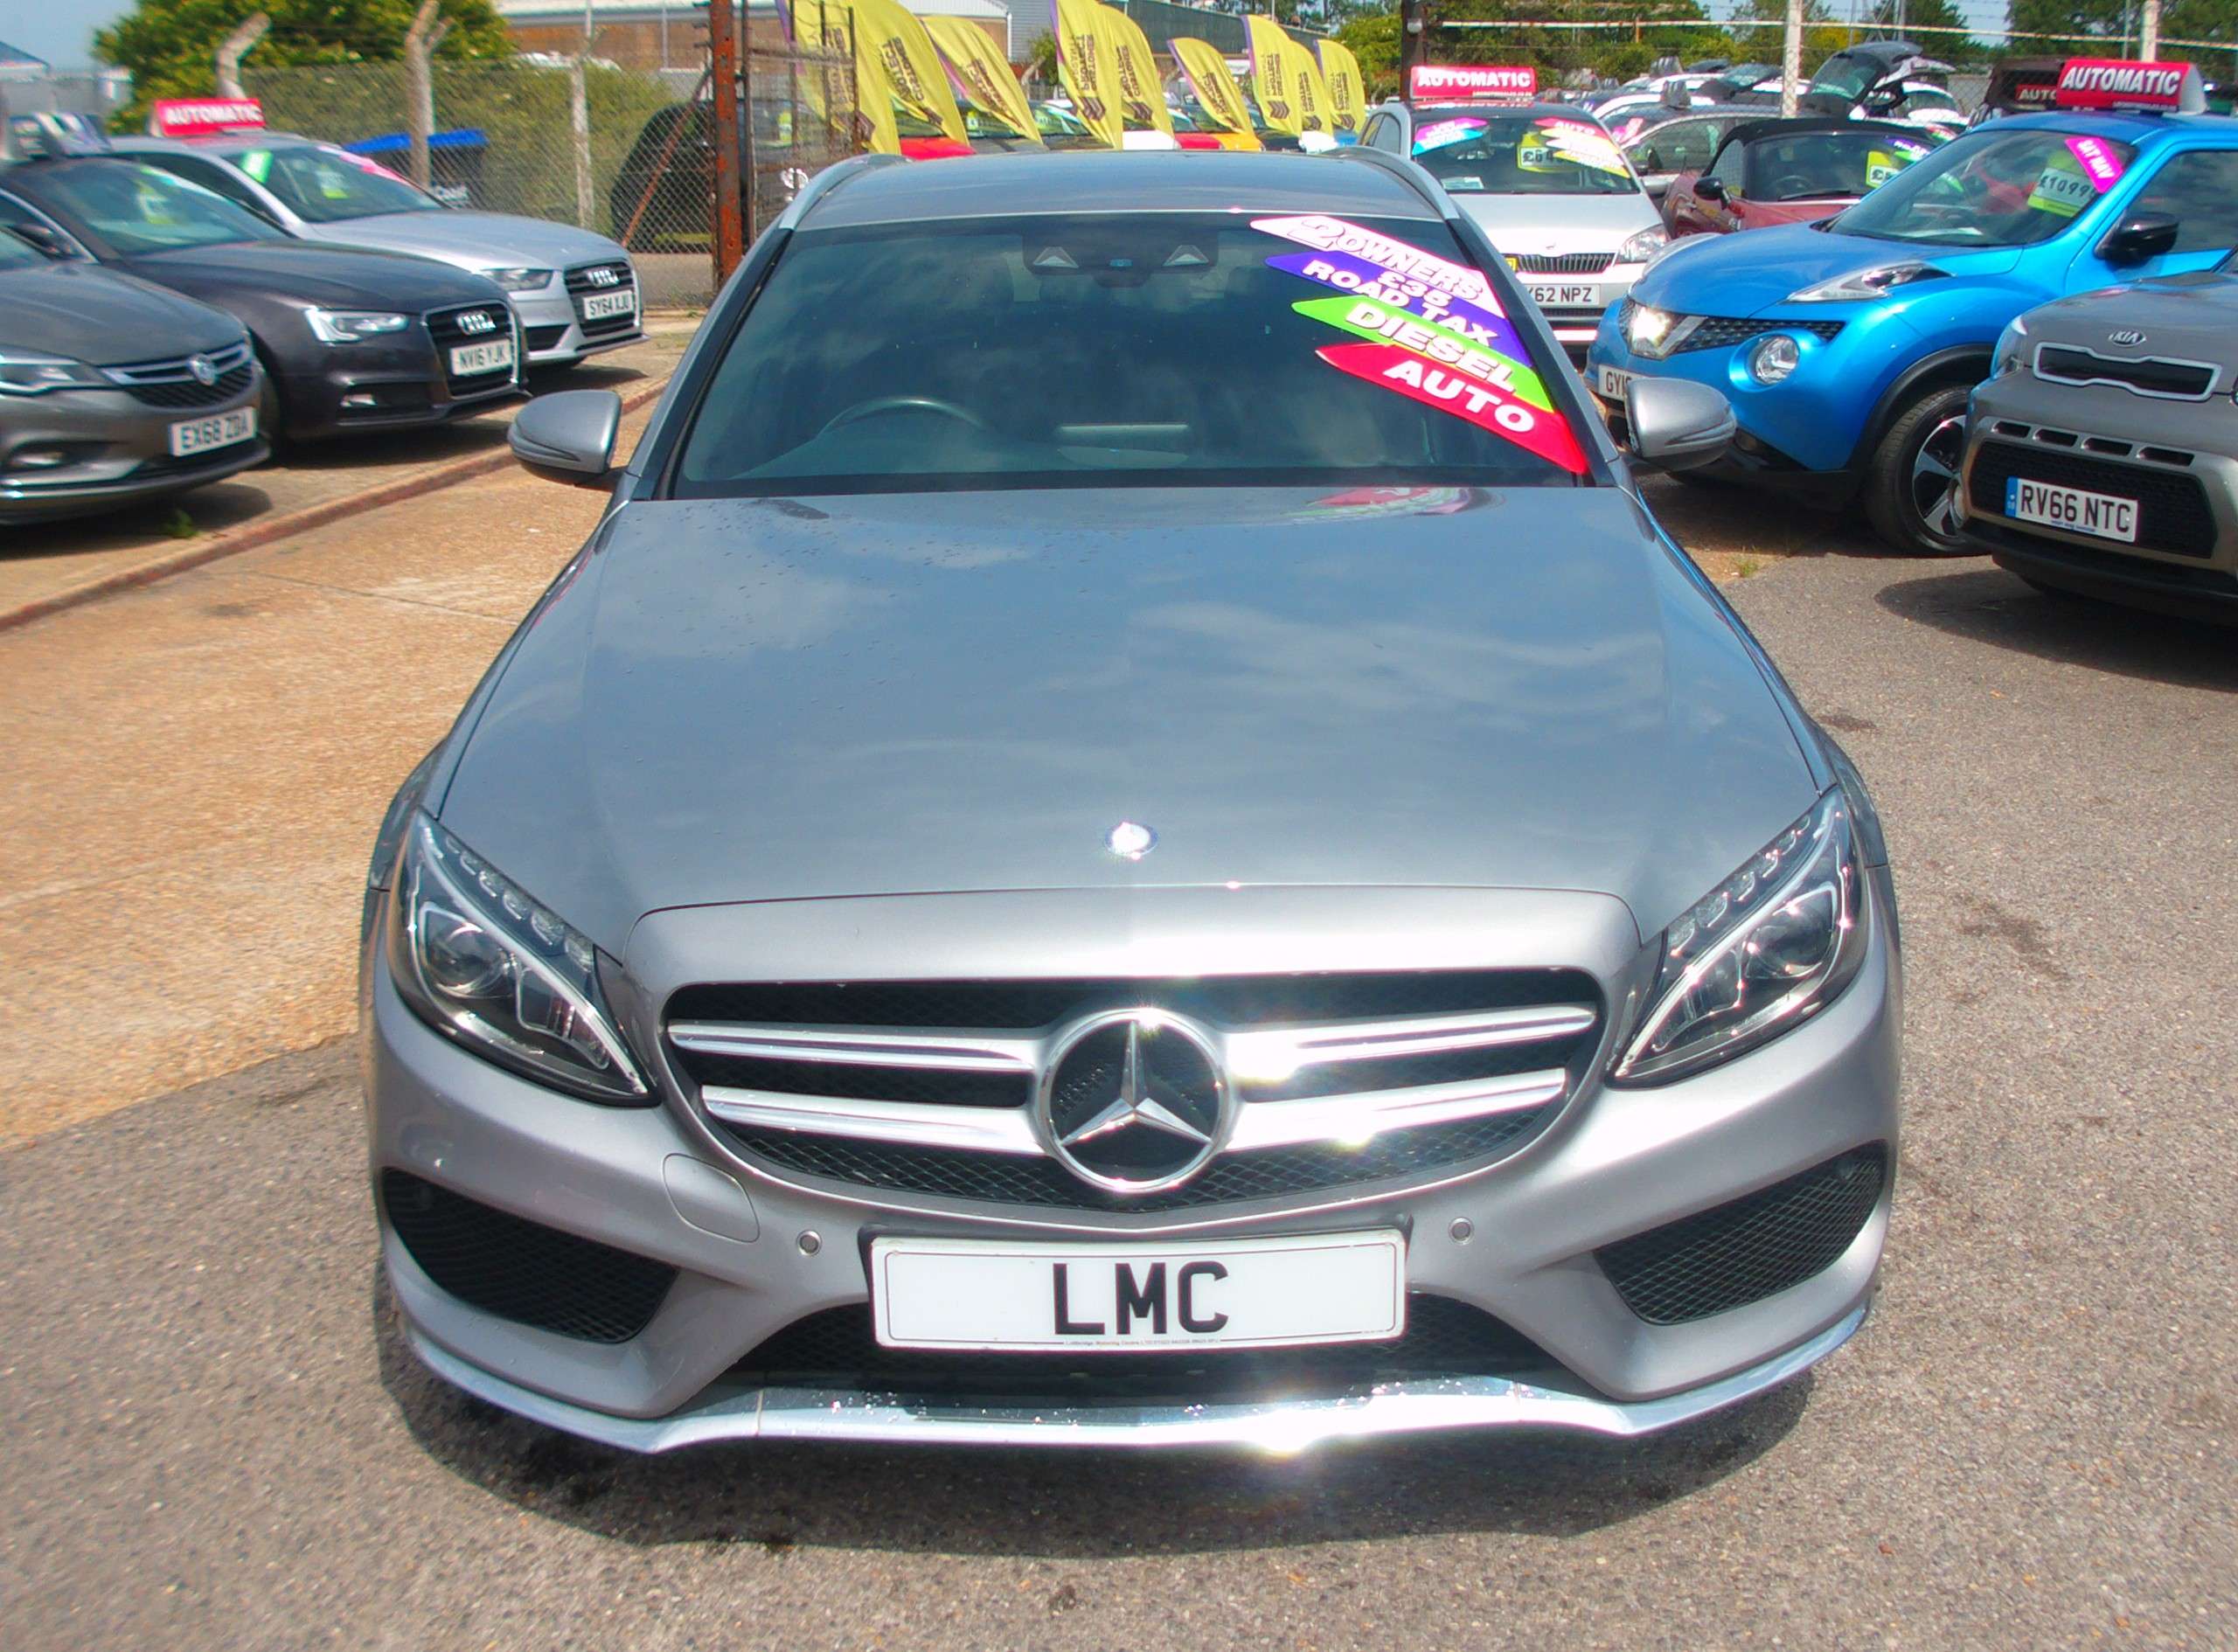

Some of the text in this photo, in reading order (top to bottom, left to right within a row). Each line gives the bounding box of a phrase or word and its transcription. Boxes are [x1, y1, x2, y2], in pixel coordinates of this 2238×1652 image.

[1417, 67, 1531, 87] AUTOMATIC
[2061, 66, 2182, 96] AUTOMATIC
[166, 104, 264, 125] AUTOMATIC
[1287, 219, 1484, 300] 2 OWNERS
[1302, 260, 1499, 347] ROAD TAX
[1377, 271, 1454, 308] £35
[1560, 287, 1592, 302] NPZ
[1345, 302, 1515, 393] DIESEL
[1383, 359, 1535, 433] AUTO
[2020, 484, 2130, 533] RV66 NTC
[1053, 1260, 1229, 1336] LMC
